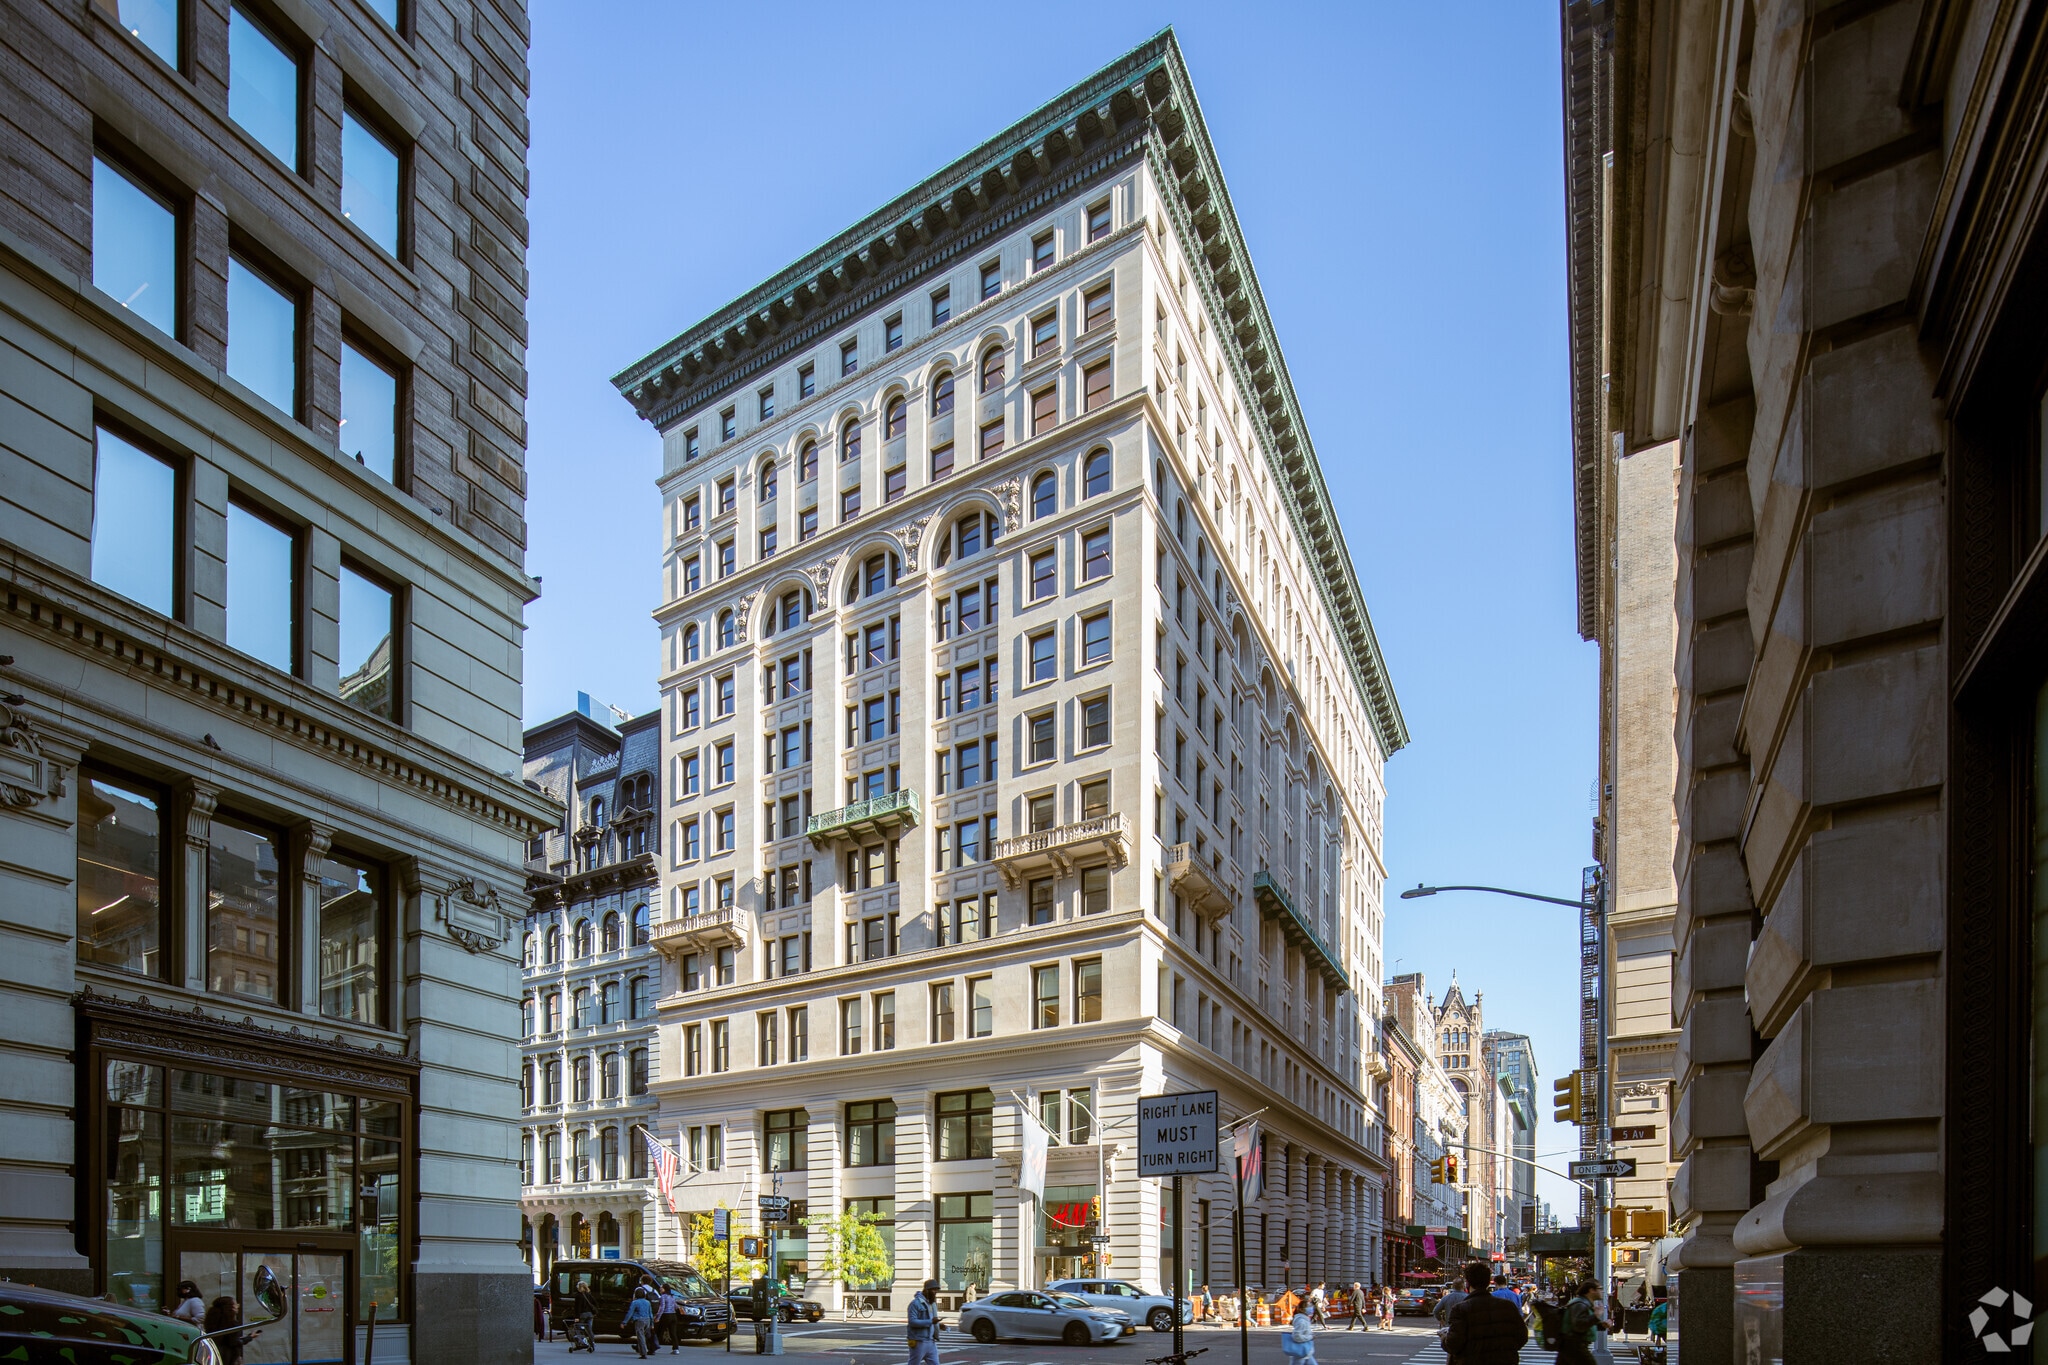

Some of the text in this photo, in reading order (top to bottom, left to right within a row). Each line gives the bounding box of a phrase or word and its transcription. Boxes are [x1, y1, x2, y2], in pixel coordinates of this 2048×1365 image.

[1143, 1102, 1213, 1120] RIGHT LANE
[1157, 1126, 1197, 1143] MUST
[1622, 1129, 1645, 1140] 5 Av
[1142, 1150, 1214, 1167] TURN RIGHT
[1578, 1164, 1626, 1174] ONE WAY
[1051, 1202, 1089, 1230] H&M
[951, 1265, 977, 1277] Designed
